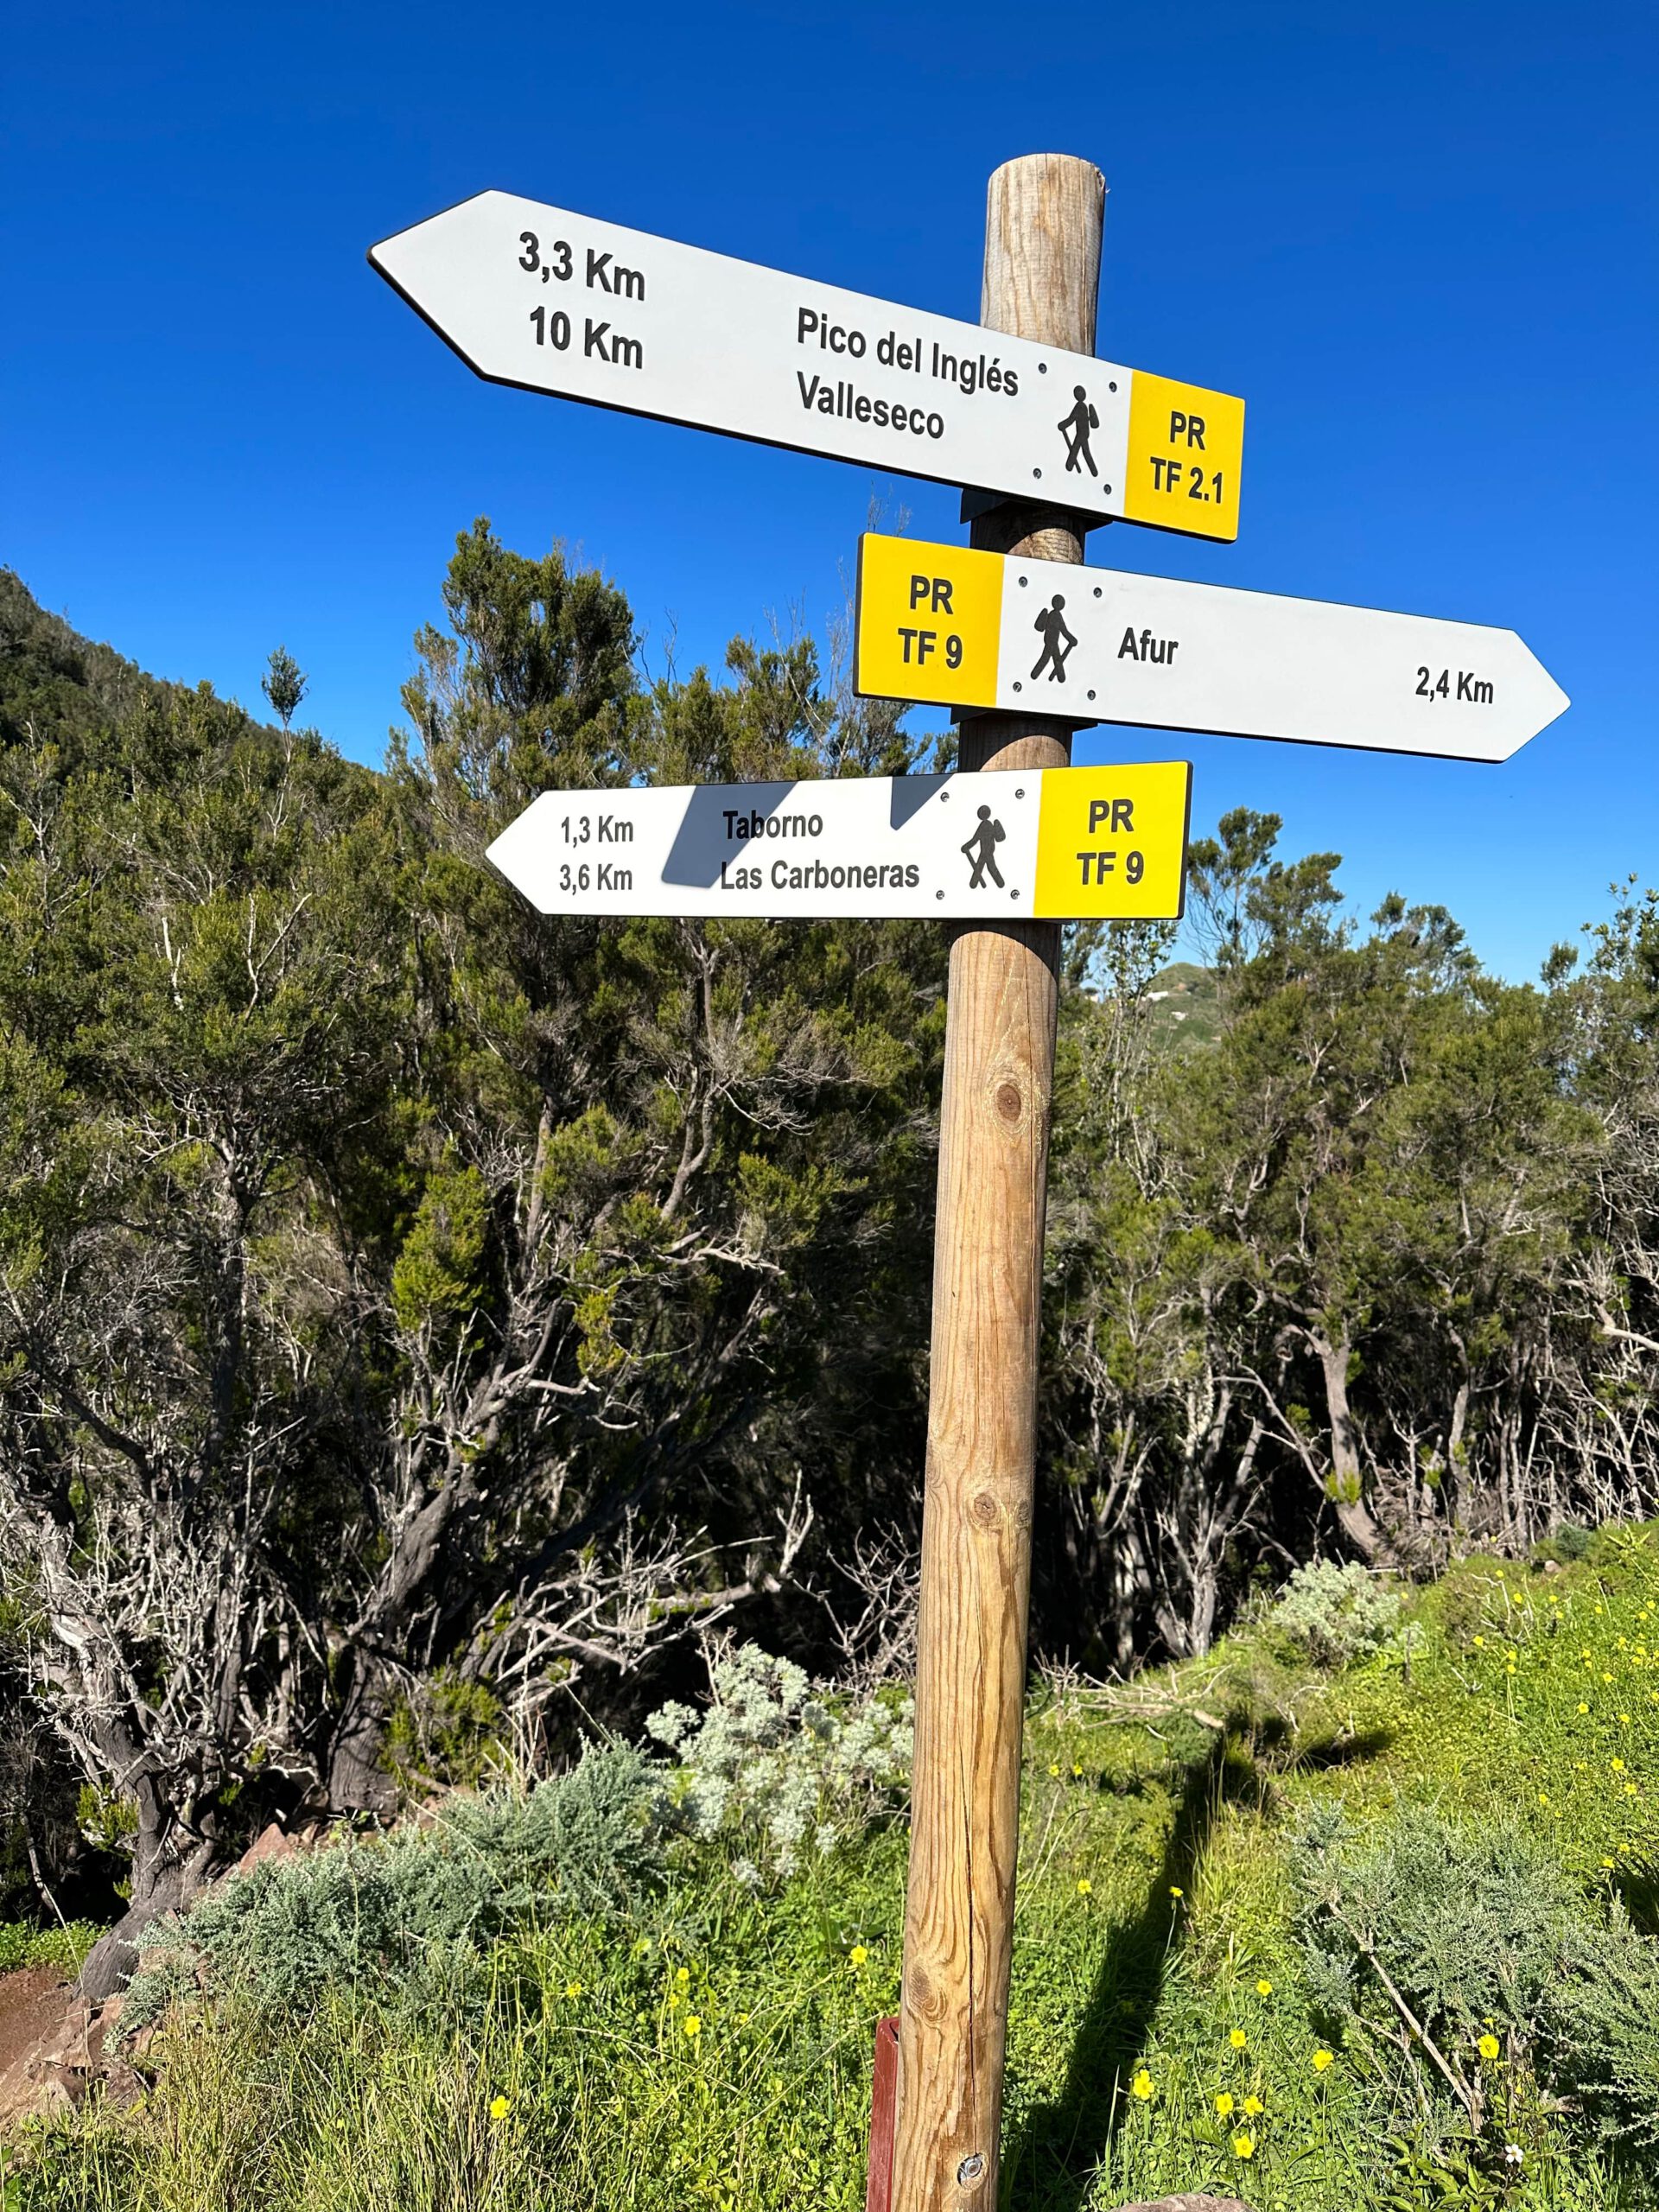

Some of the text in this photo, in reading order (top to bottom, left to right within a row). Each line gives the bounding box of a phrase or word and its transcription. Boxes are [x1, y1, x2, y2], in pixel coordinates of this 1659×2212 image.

[518, 232, 645, 302] 3,3 Km
[530, 306, 642, 369] 10 Km
[798, 307, 1018, 397] Pico del Inglés
[797, 371, 944, 439] Valleseco
[1170, 410, 1205, 451] PR
[1150, 456, 1223, 504] TF 2.1
[910, 575, 954, 615] PR
[898, 627, 963, 670] TF 9
[1117, 626, 1179, 664] Afur
[1415, 666, 1494, 704] 2,4 Km
[560, 815, 633, 849] 1,3 Km
[723, 810, 823, 839] Taborno
[1089, 798, 1134, 834] PR
[559, 863, 632, 895] 3,6 Km
[721, 860, 919, 890] Las Carboneras
[1077, 850, 1144, 885] TF 9
